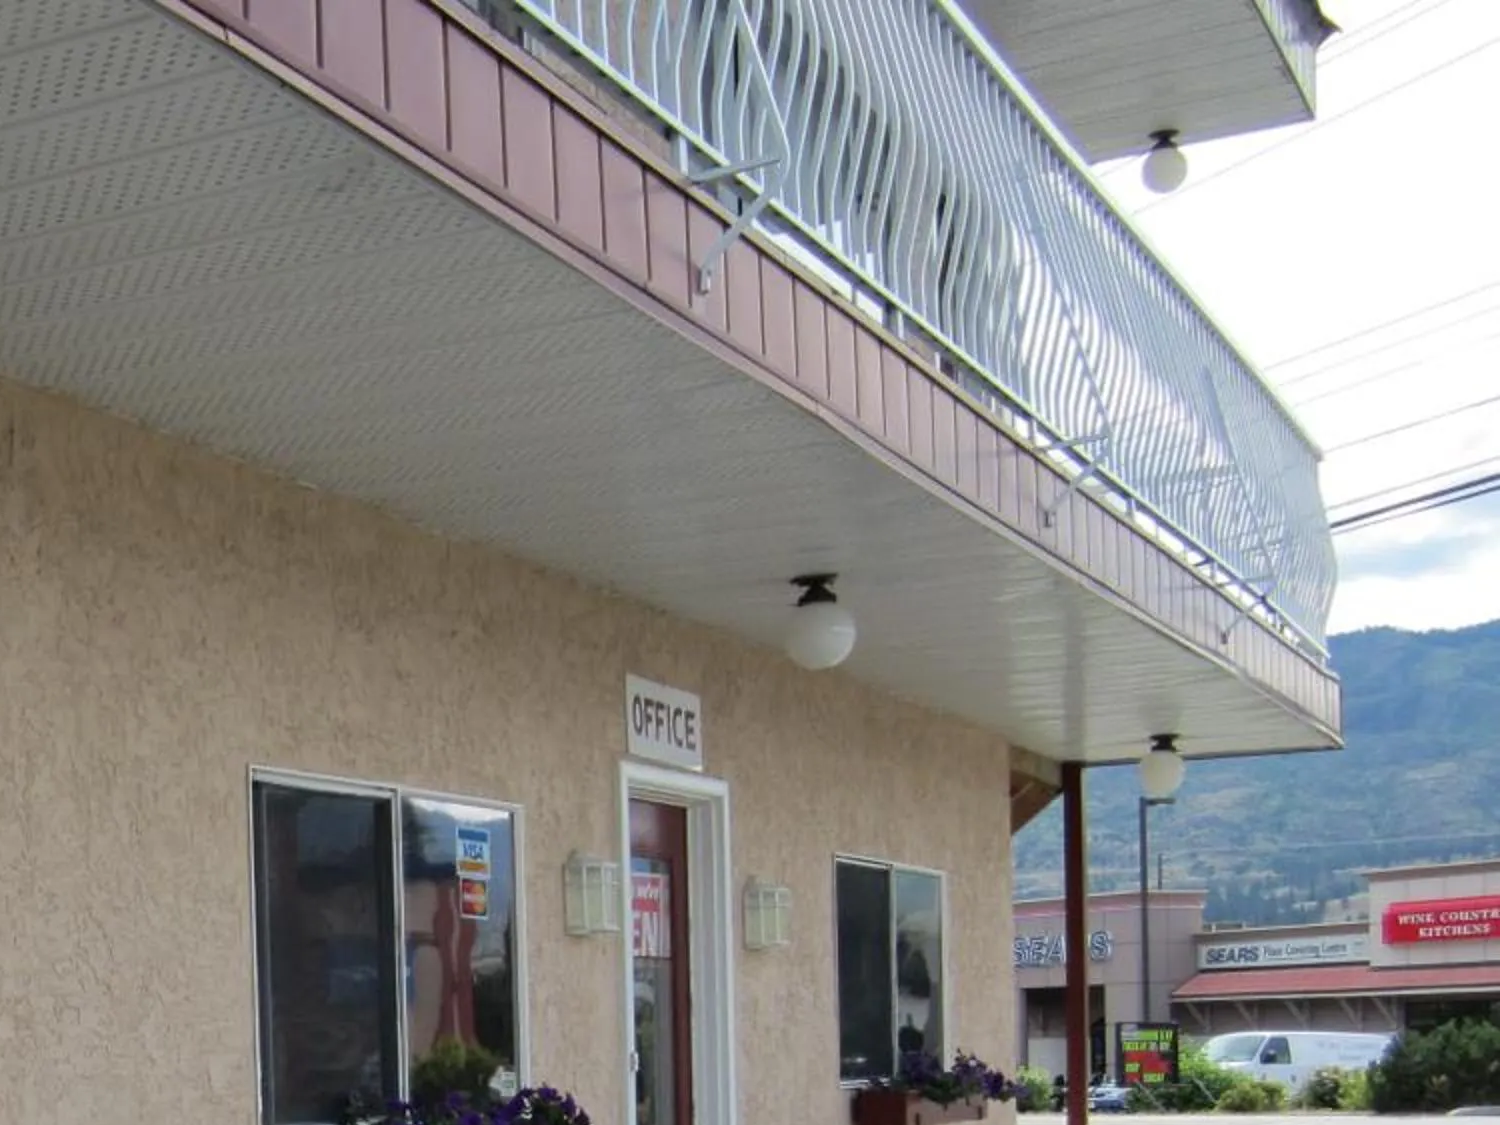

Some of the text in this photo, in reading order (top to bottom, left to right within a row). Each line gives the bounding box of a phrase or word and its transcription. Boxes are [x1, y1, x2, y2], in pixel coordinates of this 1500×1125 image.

[633, 694, 696, 752] OFFICE
[1419, 923, 1491, 937] KITCHENS
[1013, 931, 1113, 966] SEAS
[1206, 945, 1259, 965] SEARS
